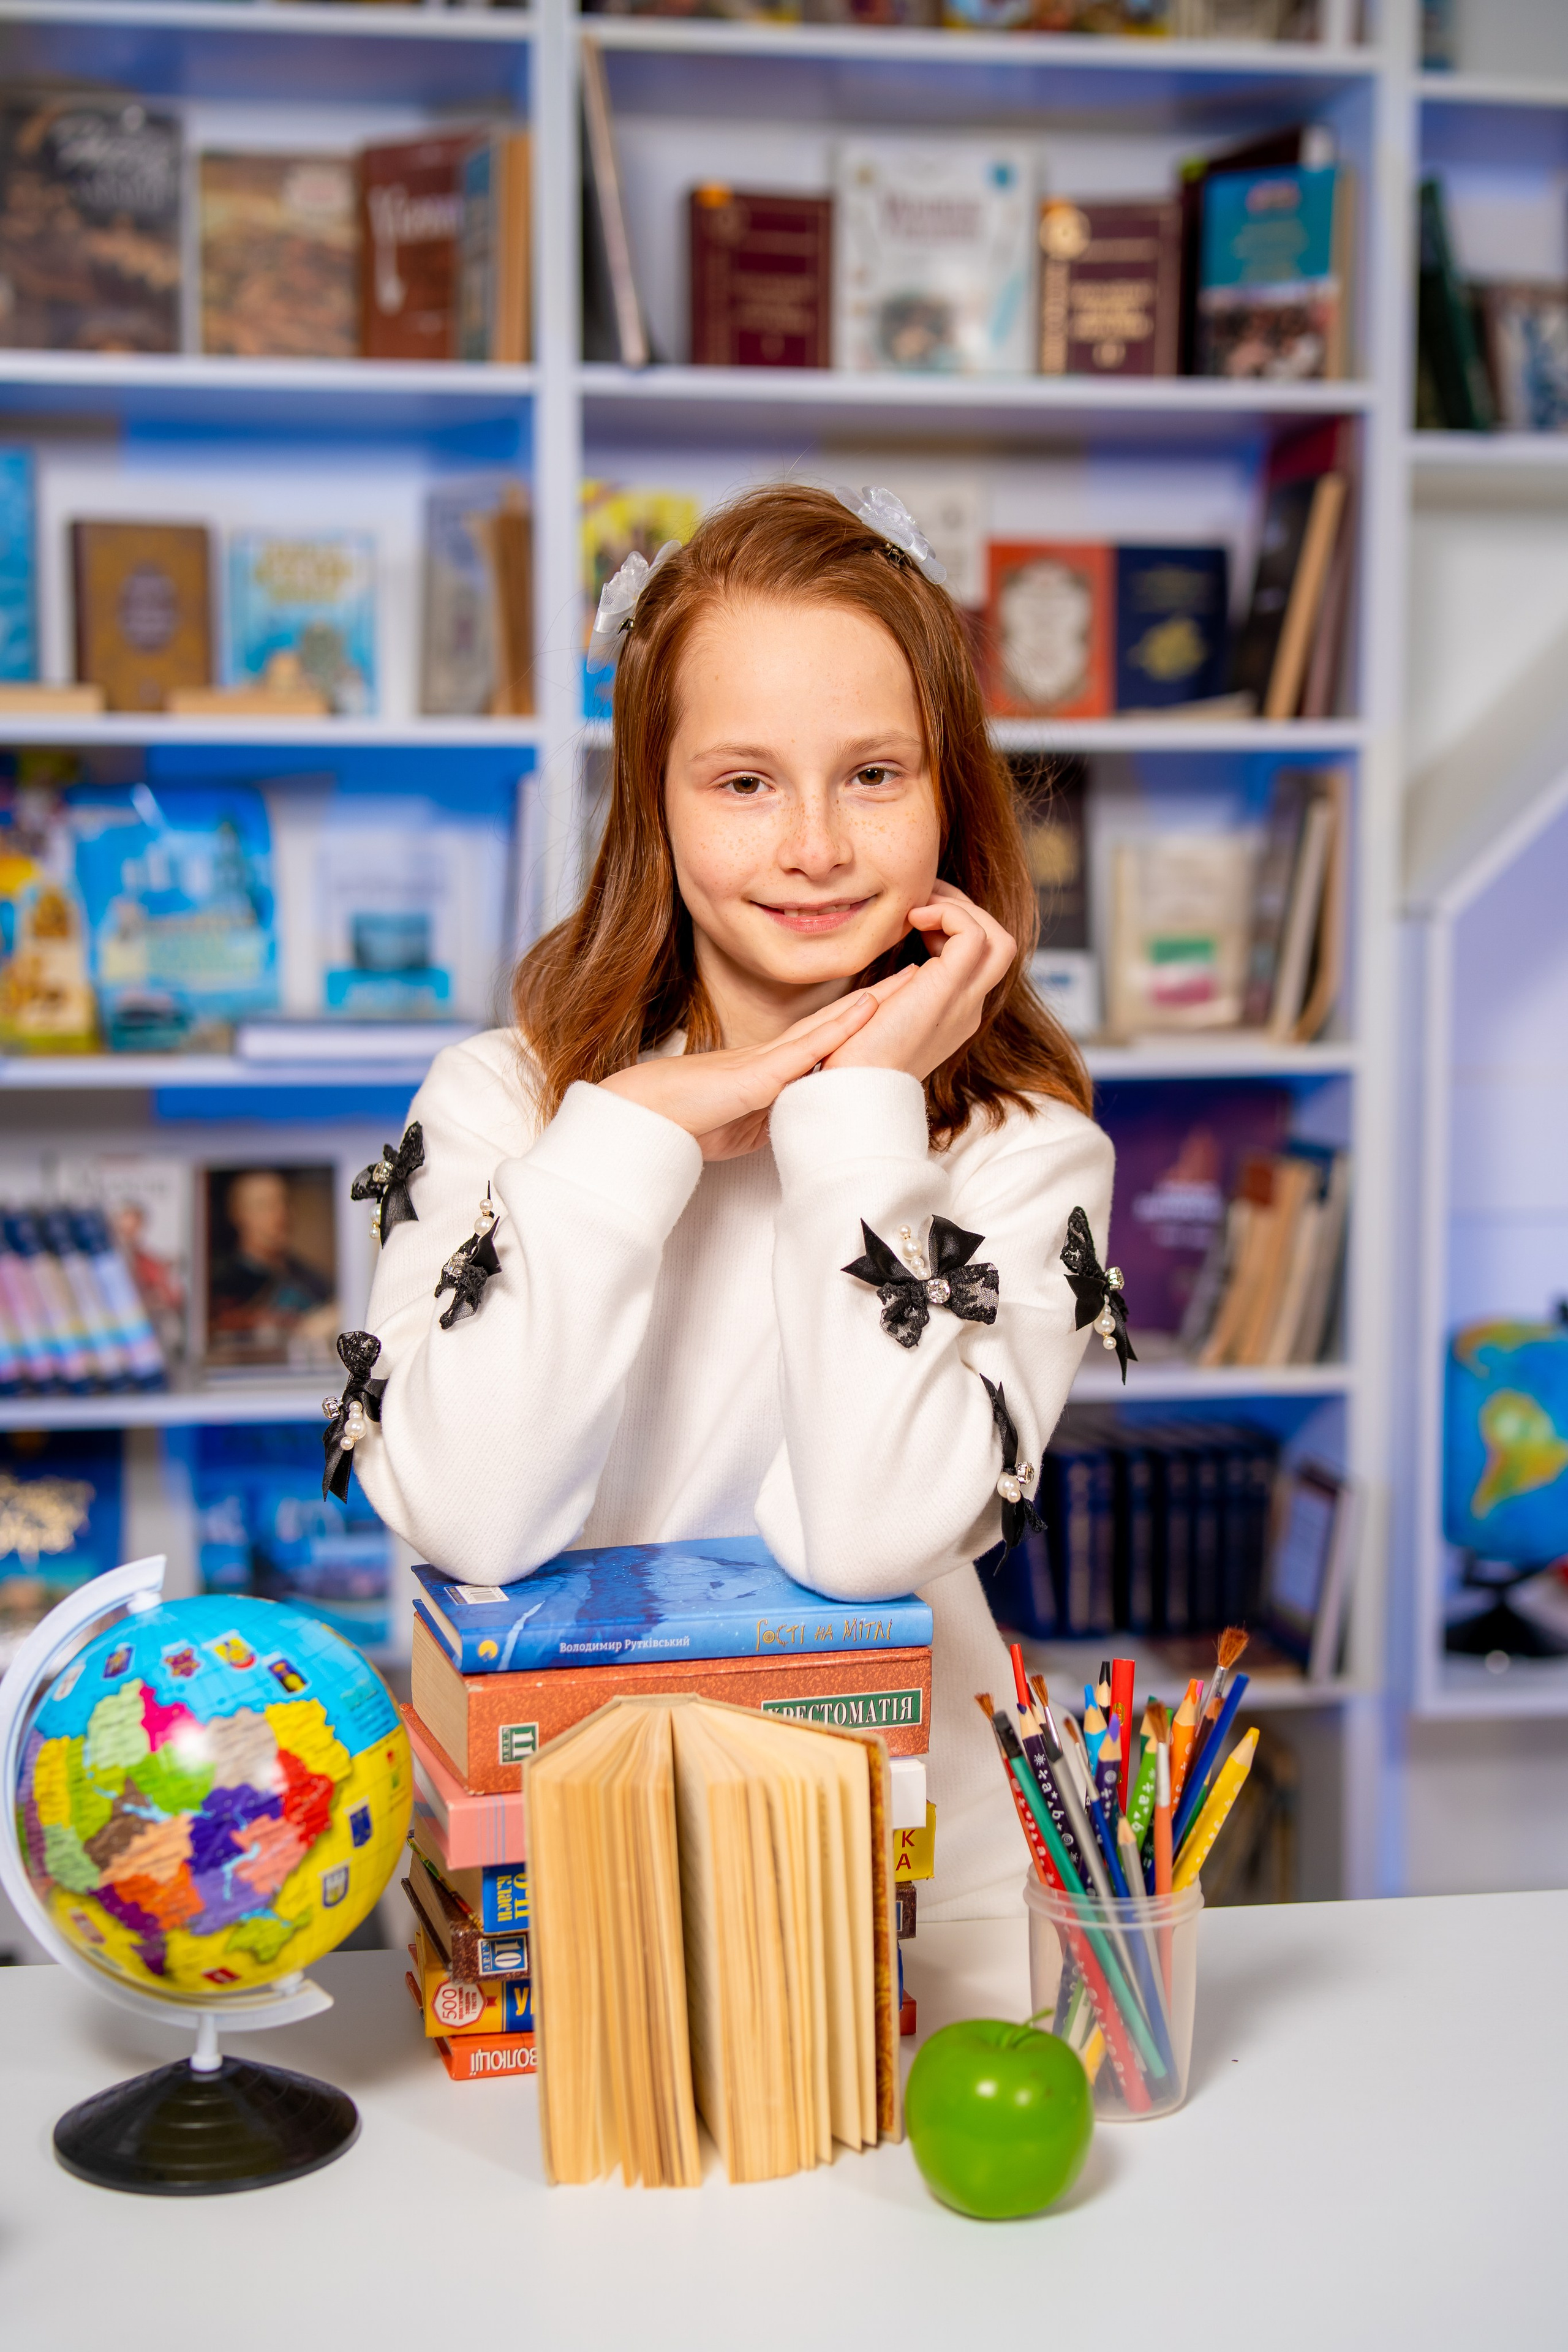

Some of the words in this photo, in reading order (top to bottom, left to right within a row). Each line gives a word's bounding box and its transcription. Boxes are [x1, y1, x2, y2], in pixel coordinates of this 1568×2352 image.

[559, 1640, 622, 1653] Володимир
[624, 1635, 690, 1651] Рутківський
[767, 1696, 913, 1726] РЕСТОМАТІЯ
[494, 1938, 522, 1969] 10
[442, 1988, 458, 2019] 500
